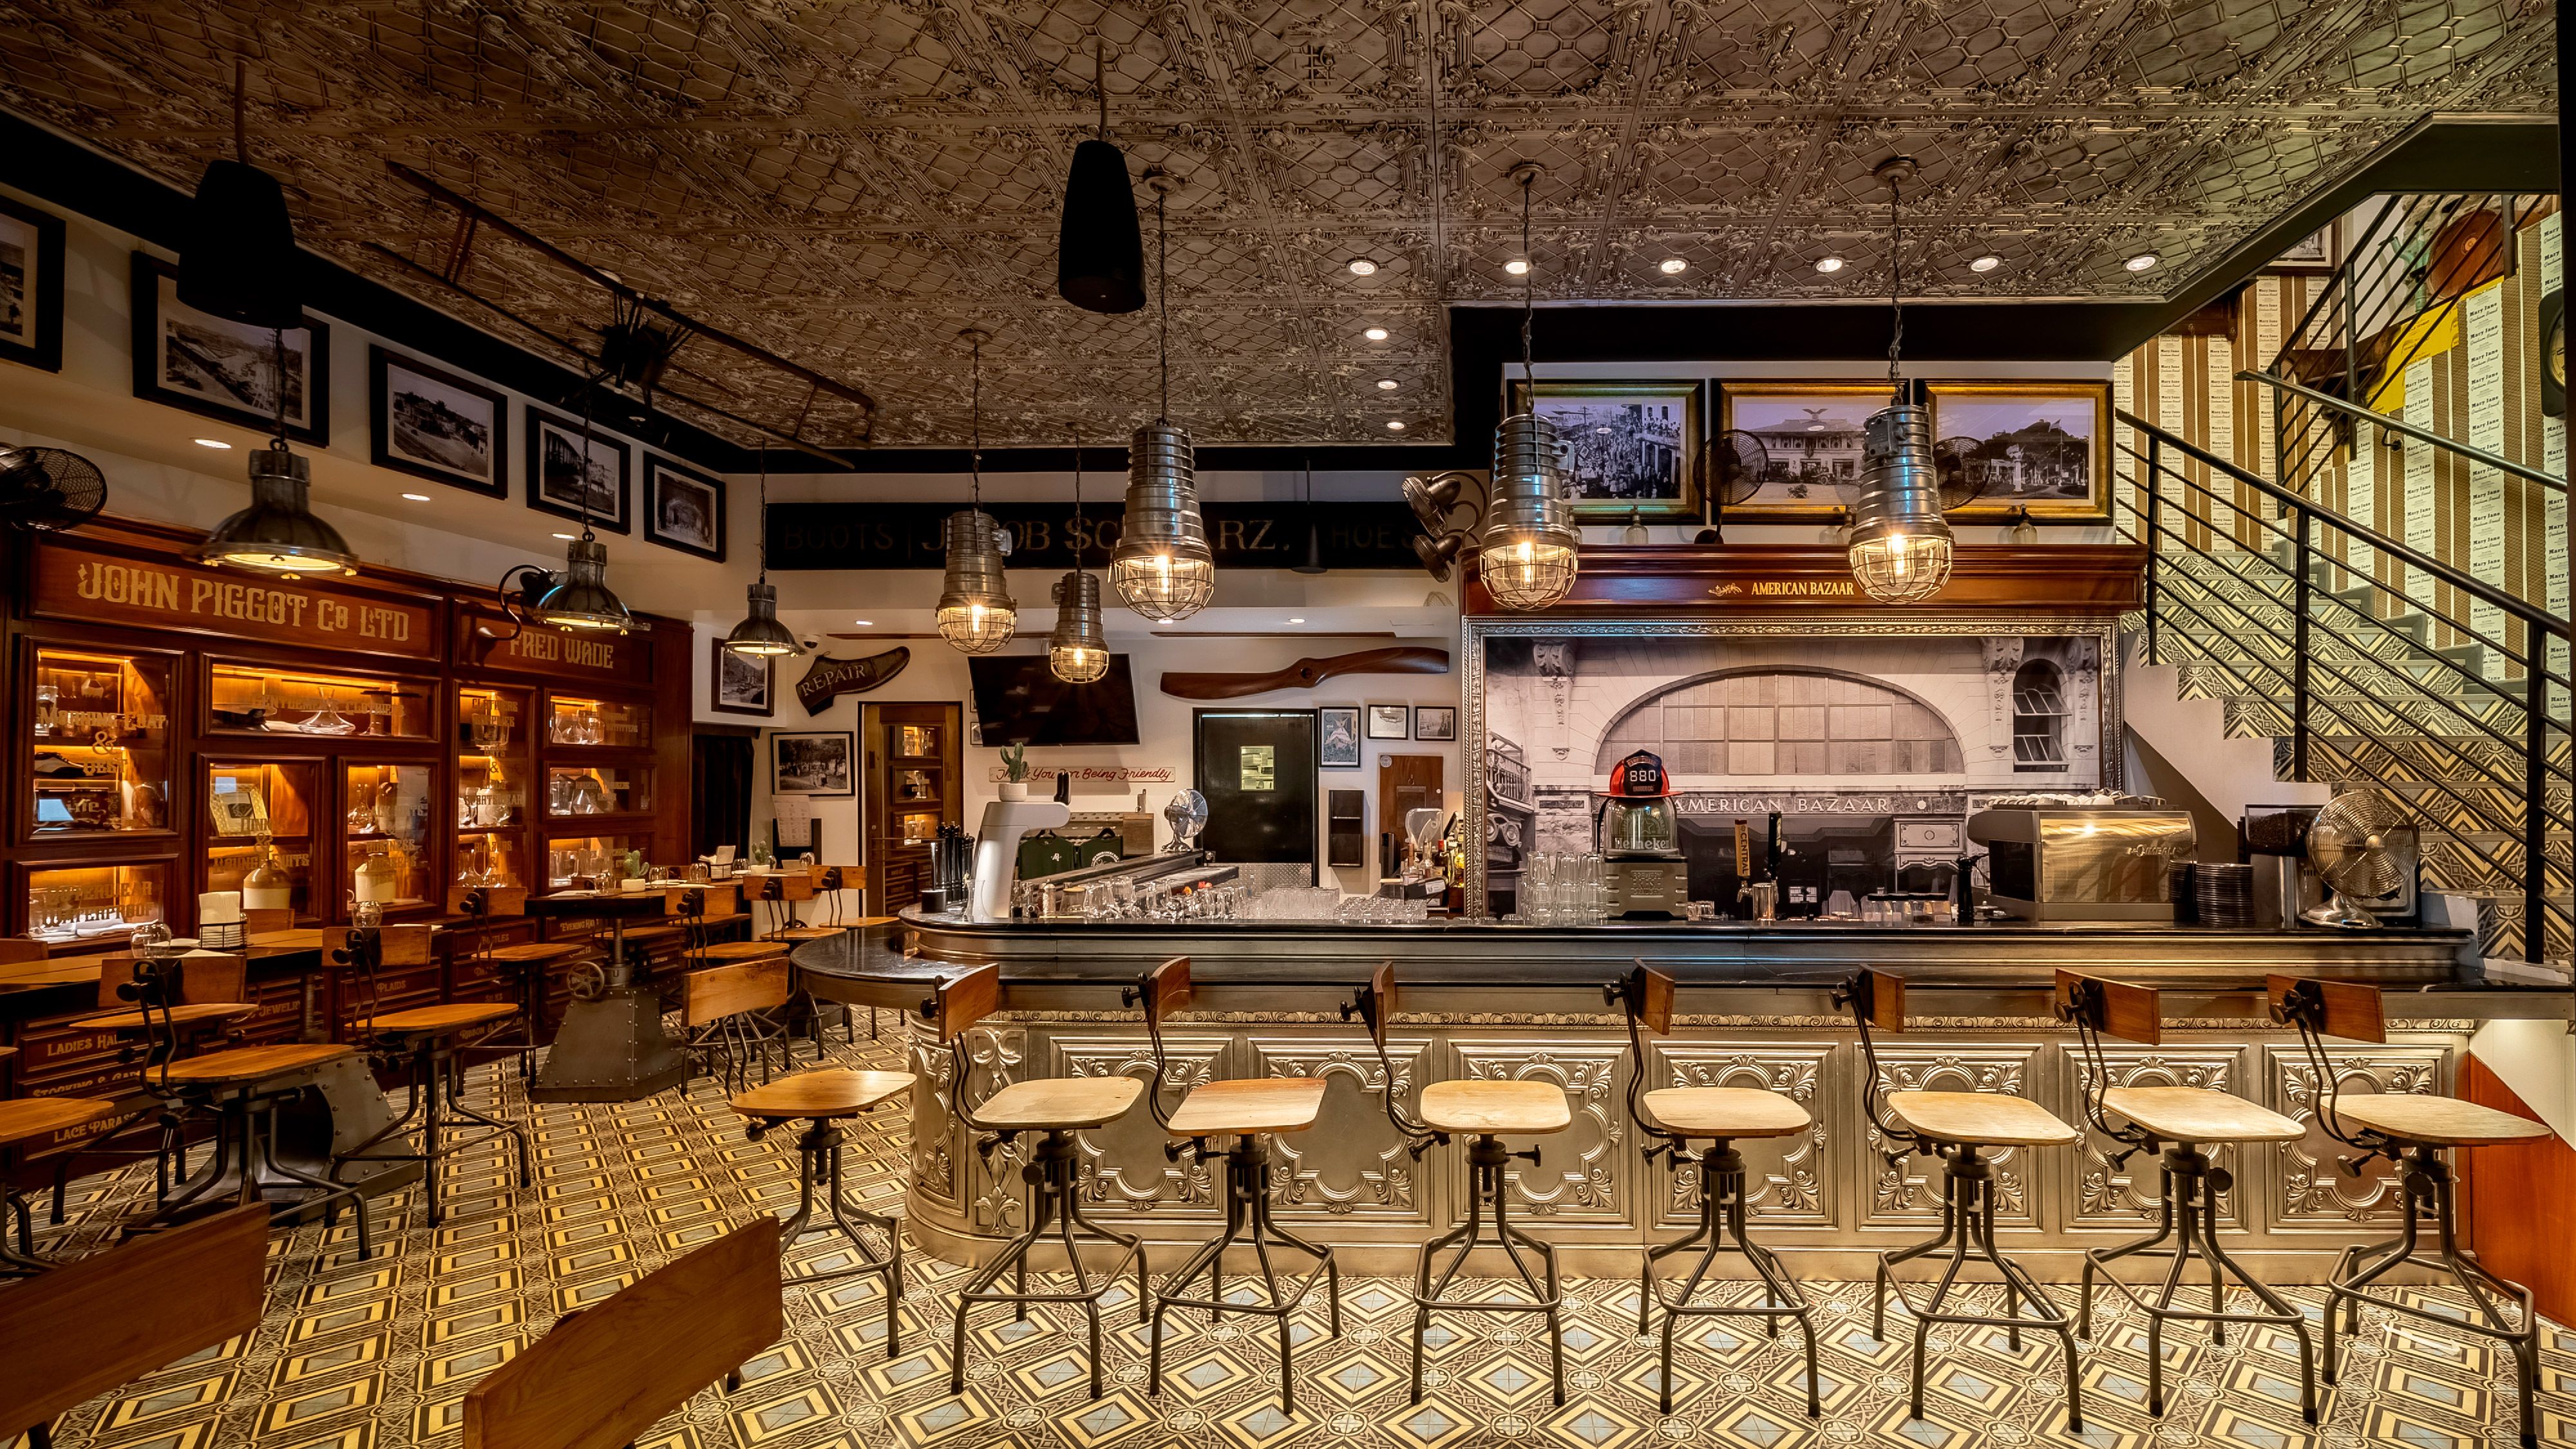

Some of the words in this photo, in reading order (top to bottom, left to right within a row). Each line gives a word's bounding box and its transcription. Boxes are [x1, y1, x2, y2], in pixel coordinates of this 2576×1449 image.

[2544, 227, 2559, 237] Mary
[2545, 251, 2560, 260] Mary
[2545, 276, 2561, 285] Mary
[2548, 424, 2563, 432] Mary
[783, 523, 894, 551] BOOTS
[921, 517, 1050, 552] JOB
[1751, 582, 1807, 595] AMERICAN
[1810, 582, 1855, 595] BAZAAR
[77, 562, 179, 611] JOHN
[191, 578, 308, 627] PIGGOT
[360, 605, 410, 641] LTD
[510, 629, 558, 661] FRED
[564, 639, 614, 669] WADE
[800, 665, 866, 697] REPAIR
[40, 706, 117, 728] MORNING
[124, 710, 166, 730] COAT
[92, 731, 117, 755] &
[1030, 768, 1055, 781] You
[1082, 768, 1115, 781] Being
[1118, 768, 1170, 781] Friendly
[1630, 770, 1656, 782] 880
[465, 795, 526, 806] SORTSWEAR
[1674, 799, 1782, 813] AMERICAN
[1797, 799, 1888, 813] BAZAAR
[482, 934, 509, 944] BUTLES
[377, 980, 406, 993] PLAIDS
[48, 1038, 93, 1057] LADIES
[54, 1124, 87, 1143] LACE
